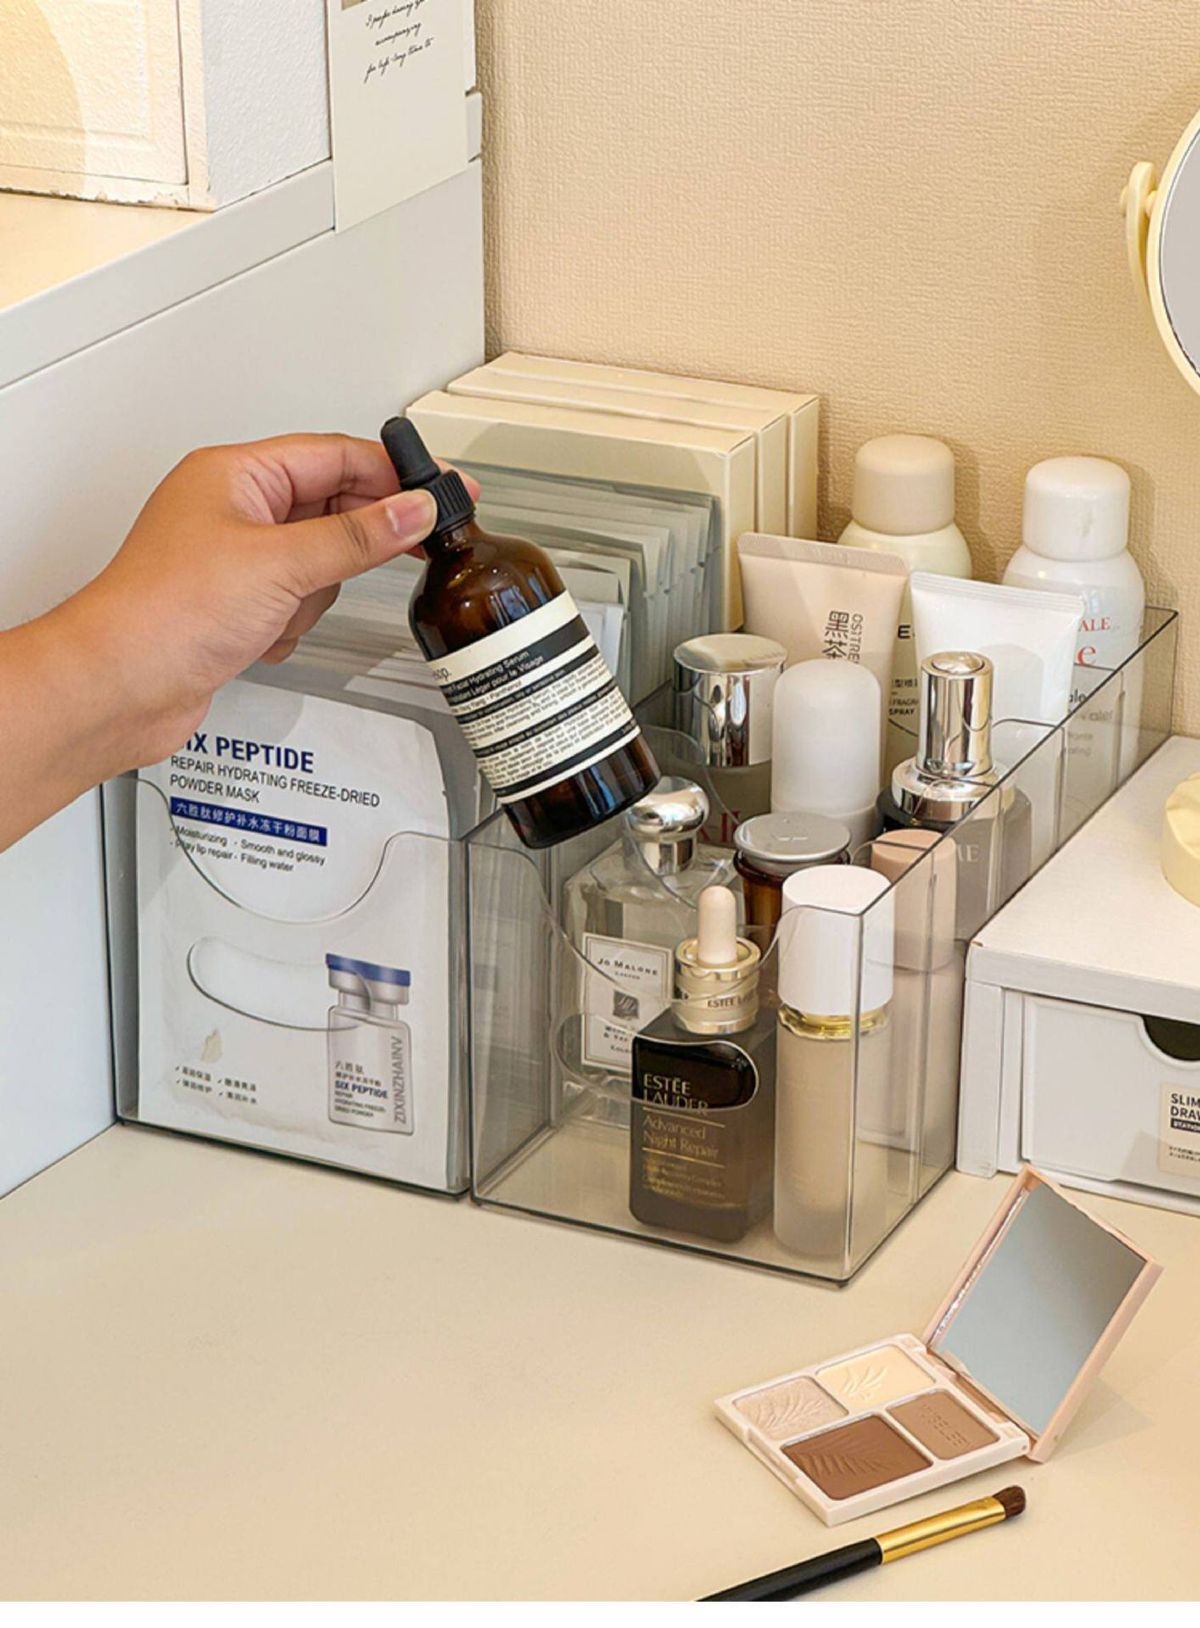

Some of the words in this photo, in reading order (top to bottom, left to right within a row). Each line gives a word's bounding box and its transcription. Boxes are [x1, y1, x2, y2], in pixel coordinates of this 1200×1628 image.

[502, 651, 530, 669] Serum
[184, 732, 208, 754] IX
[215, 736, 315, 773] PEPTIDE
[170, 774, 223, 796] POWDER
[226, 786, 260, 803] MASK
[171, 755, 215, 773] REPAIR
[217, 765, 288, 789] HYDRATING
[290, 777, 381, 808] FREEZE-DRIED
[207, 848, 233, 862] repair
[240, 851, 268, 870] Filling
[240, 838, 276, 854] Smooth
[277, 848, 294, 859] and
[351, 1083, 388, 1100] PEPTIDE
[643, 1088, 709, 1117] LAUDER
[1170, 1092, 1200, 1109] SLIM
[642, 1114, 706, 1140] Advanced
[643, 1130, 677, 1150] Night
[679, 1138, 720, 1160] Repair
